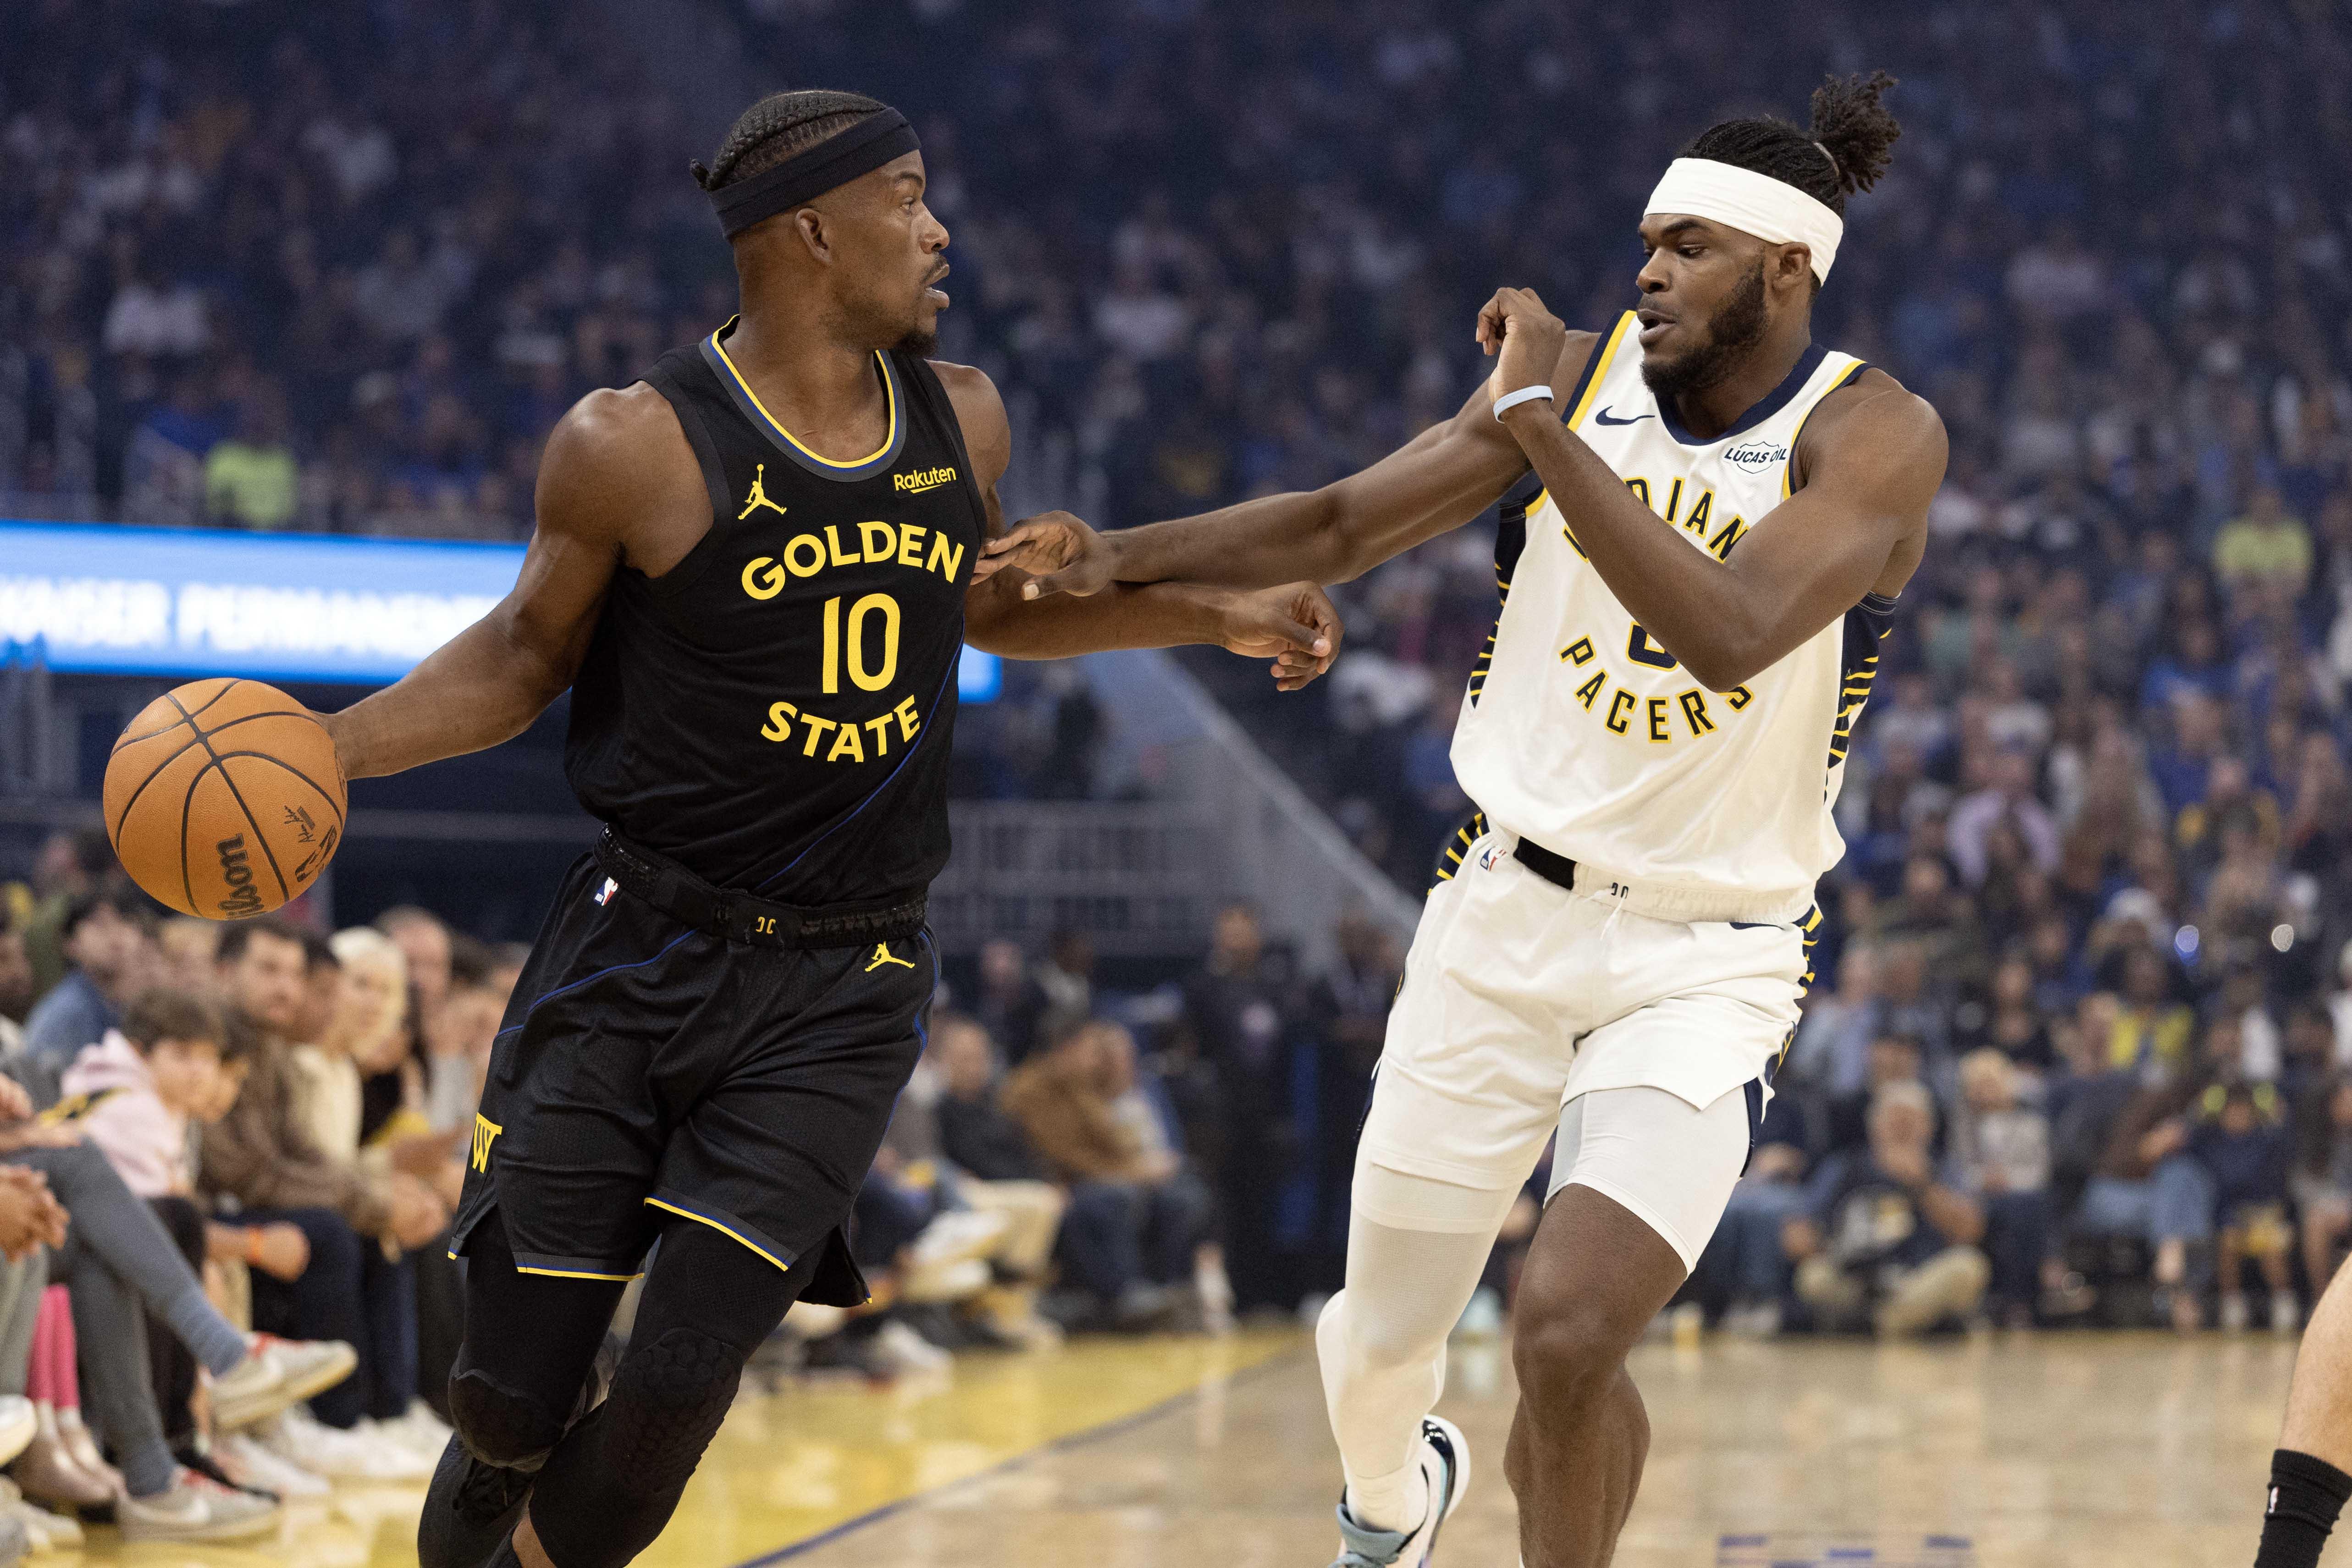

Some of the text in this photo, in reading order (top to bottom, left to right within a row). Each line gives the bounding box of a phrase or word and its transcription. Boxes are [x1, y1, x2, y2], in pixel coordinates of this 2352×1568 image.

[894, 467, 957, 491] Rakuten
[1724, 447, 1787, 464] LUCAS OIL
[741, 521, 964, 601] GOLDEN
[823, 593, 900, 694] 10
[760, 694, 920, 763] STATE
